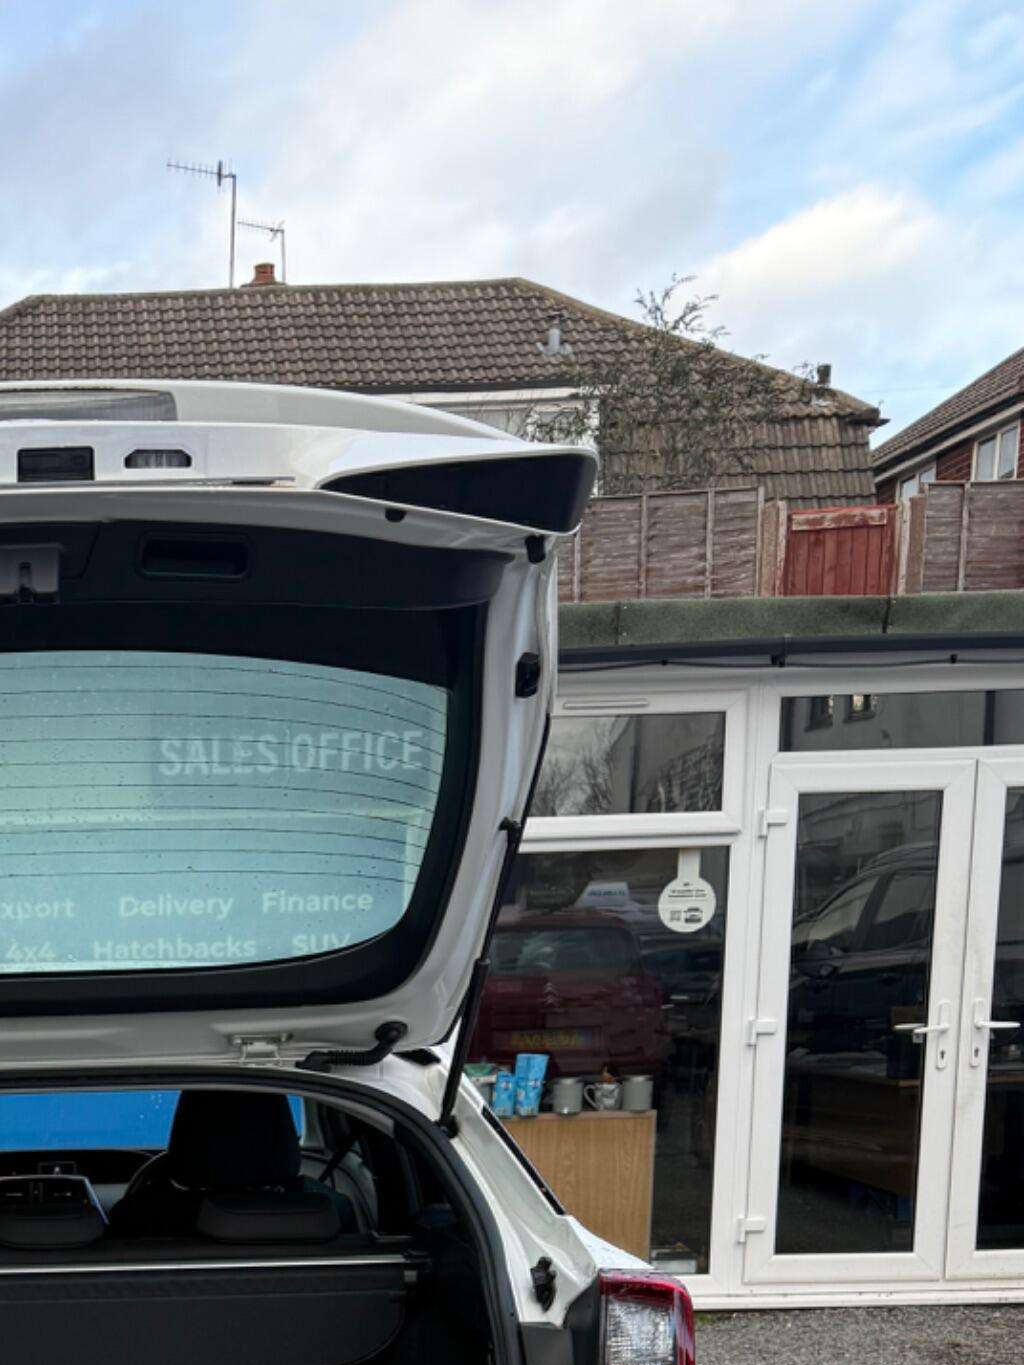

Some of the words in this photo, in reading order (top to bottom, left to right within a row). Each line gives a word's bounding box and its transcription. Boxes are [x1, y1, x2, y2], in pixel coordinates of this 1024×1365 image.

[160, 734, 277, 775] SALES
[291, 731, 423, 772] OFFICE
[120, 894, 234, 919] Delivery
[262, 890, 375, 915] Finance
[6, 941, 56, 962] 4x4
[93, 936, 257, 961] Hatchbacks
[292, 933, 352, 955] SUV
